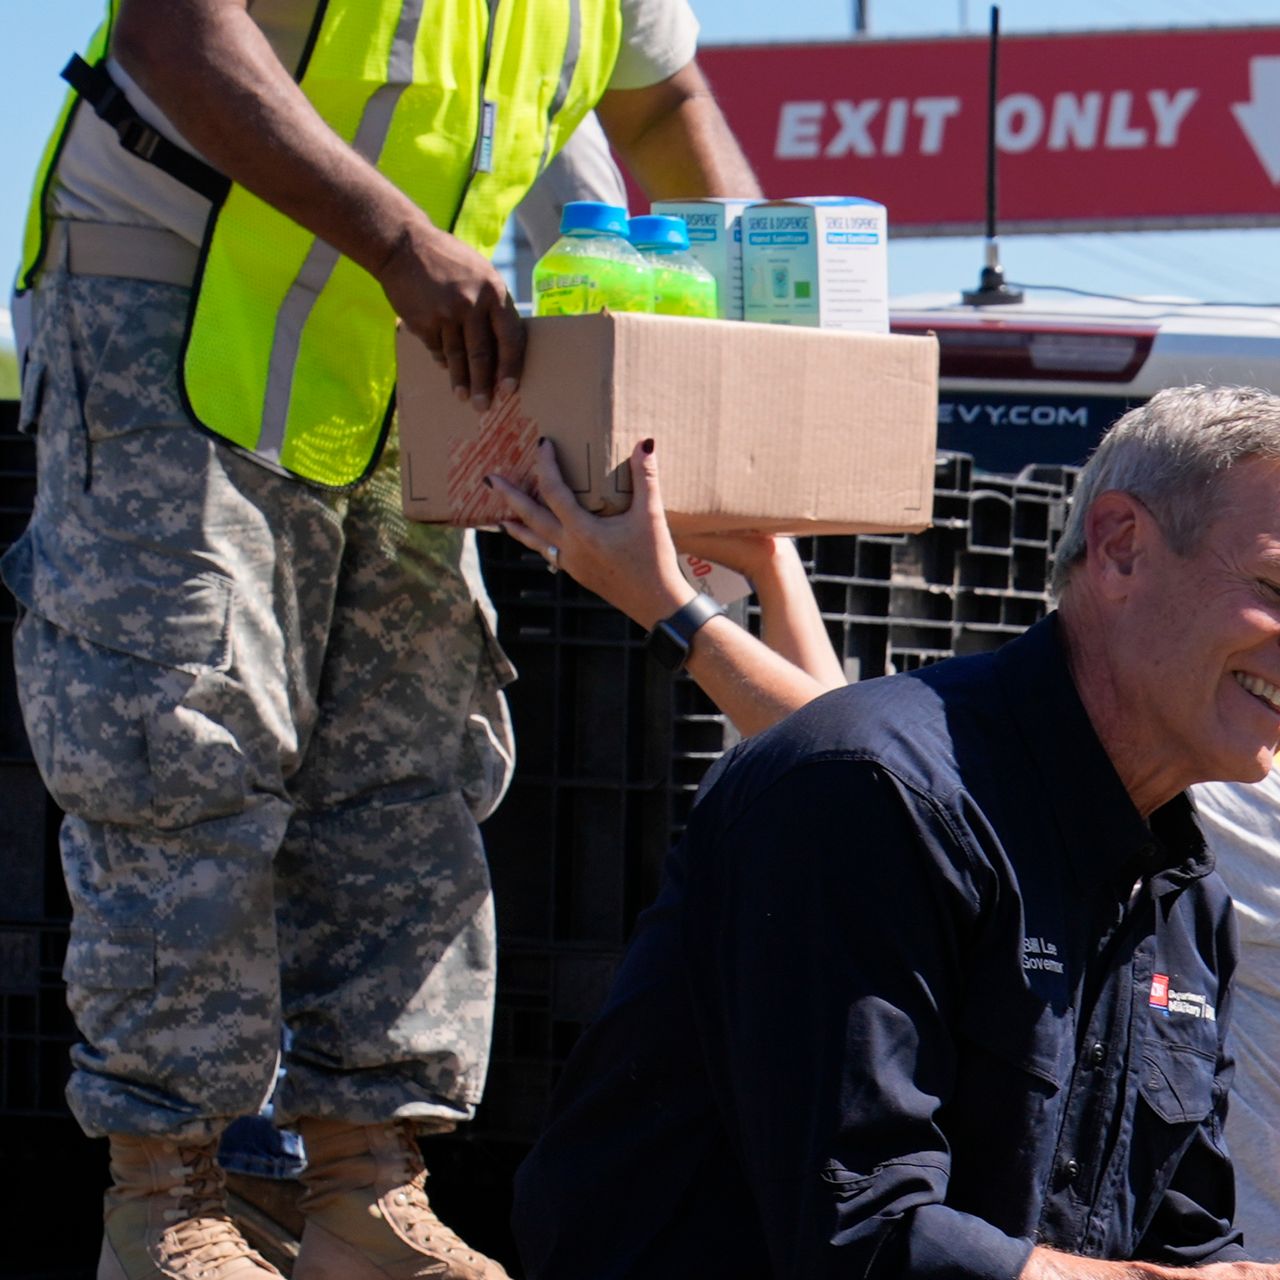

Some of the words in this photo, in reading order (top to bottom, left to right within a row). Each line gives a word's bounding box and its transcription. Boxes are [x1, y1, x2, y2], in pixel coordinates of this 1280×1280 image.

[775, 96, 961, 159] EXIT
[994, 88, 1198, 153] ONLY
[776, 216, 809, 230] DISPENSE
